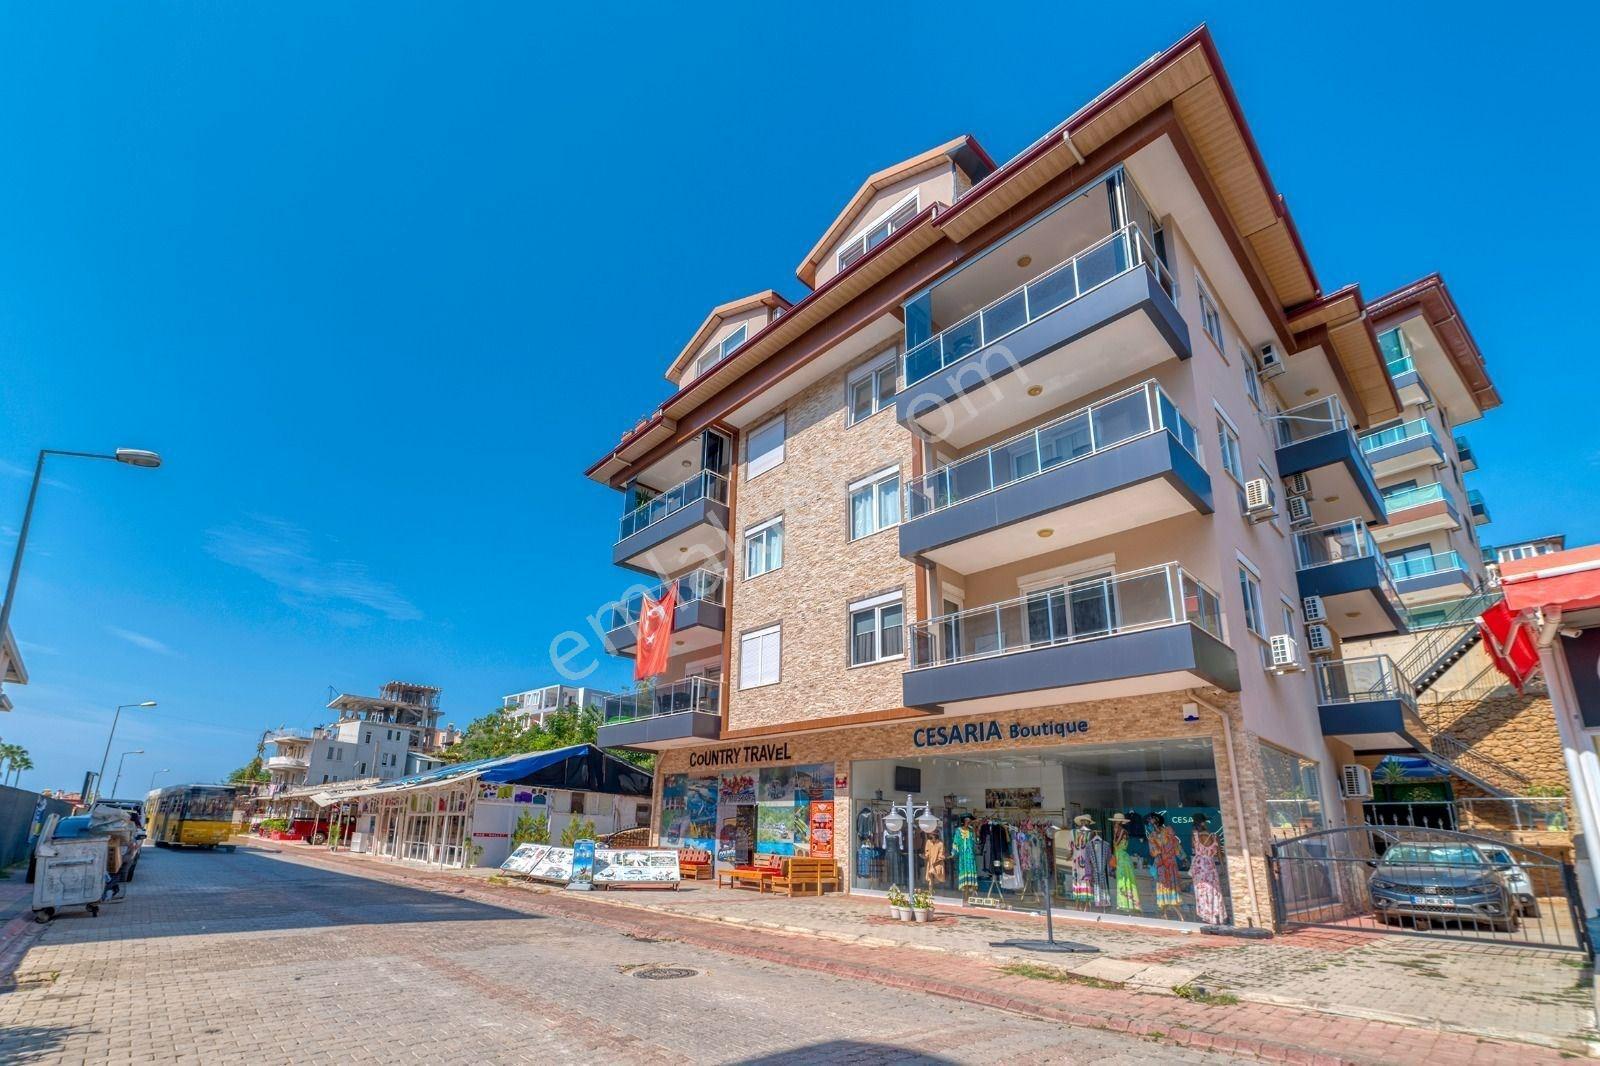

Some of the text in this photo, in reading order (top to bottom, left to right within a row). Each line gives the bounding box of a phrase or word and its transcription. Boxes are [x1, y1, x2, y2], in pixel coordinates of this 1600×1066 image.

[913, 719, 1089, 748] CESARIA Boutique
[689, 742, 792, 767] COUNTRY TRAVEL
[1171, 816, 1195, 824] CESA
